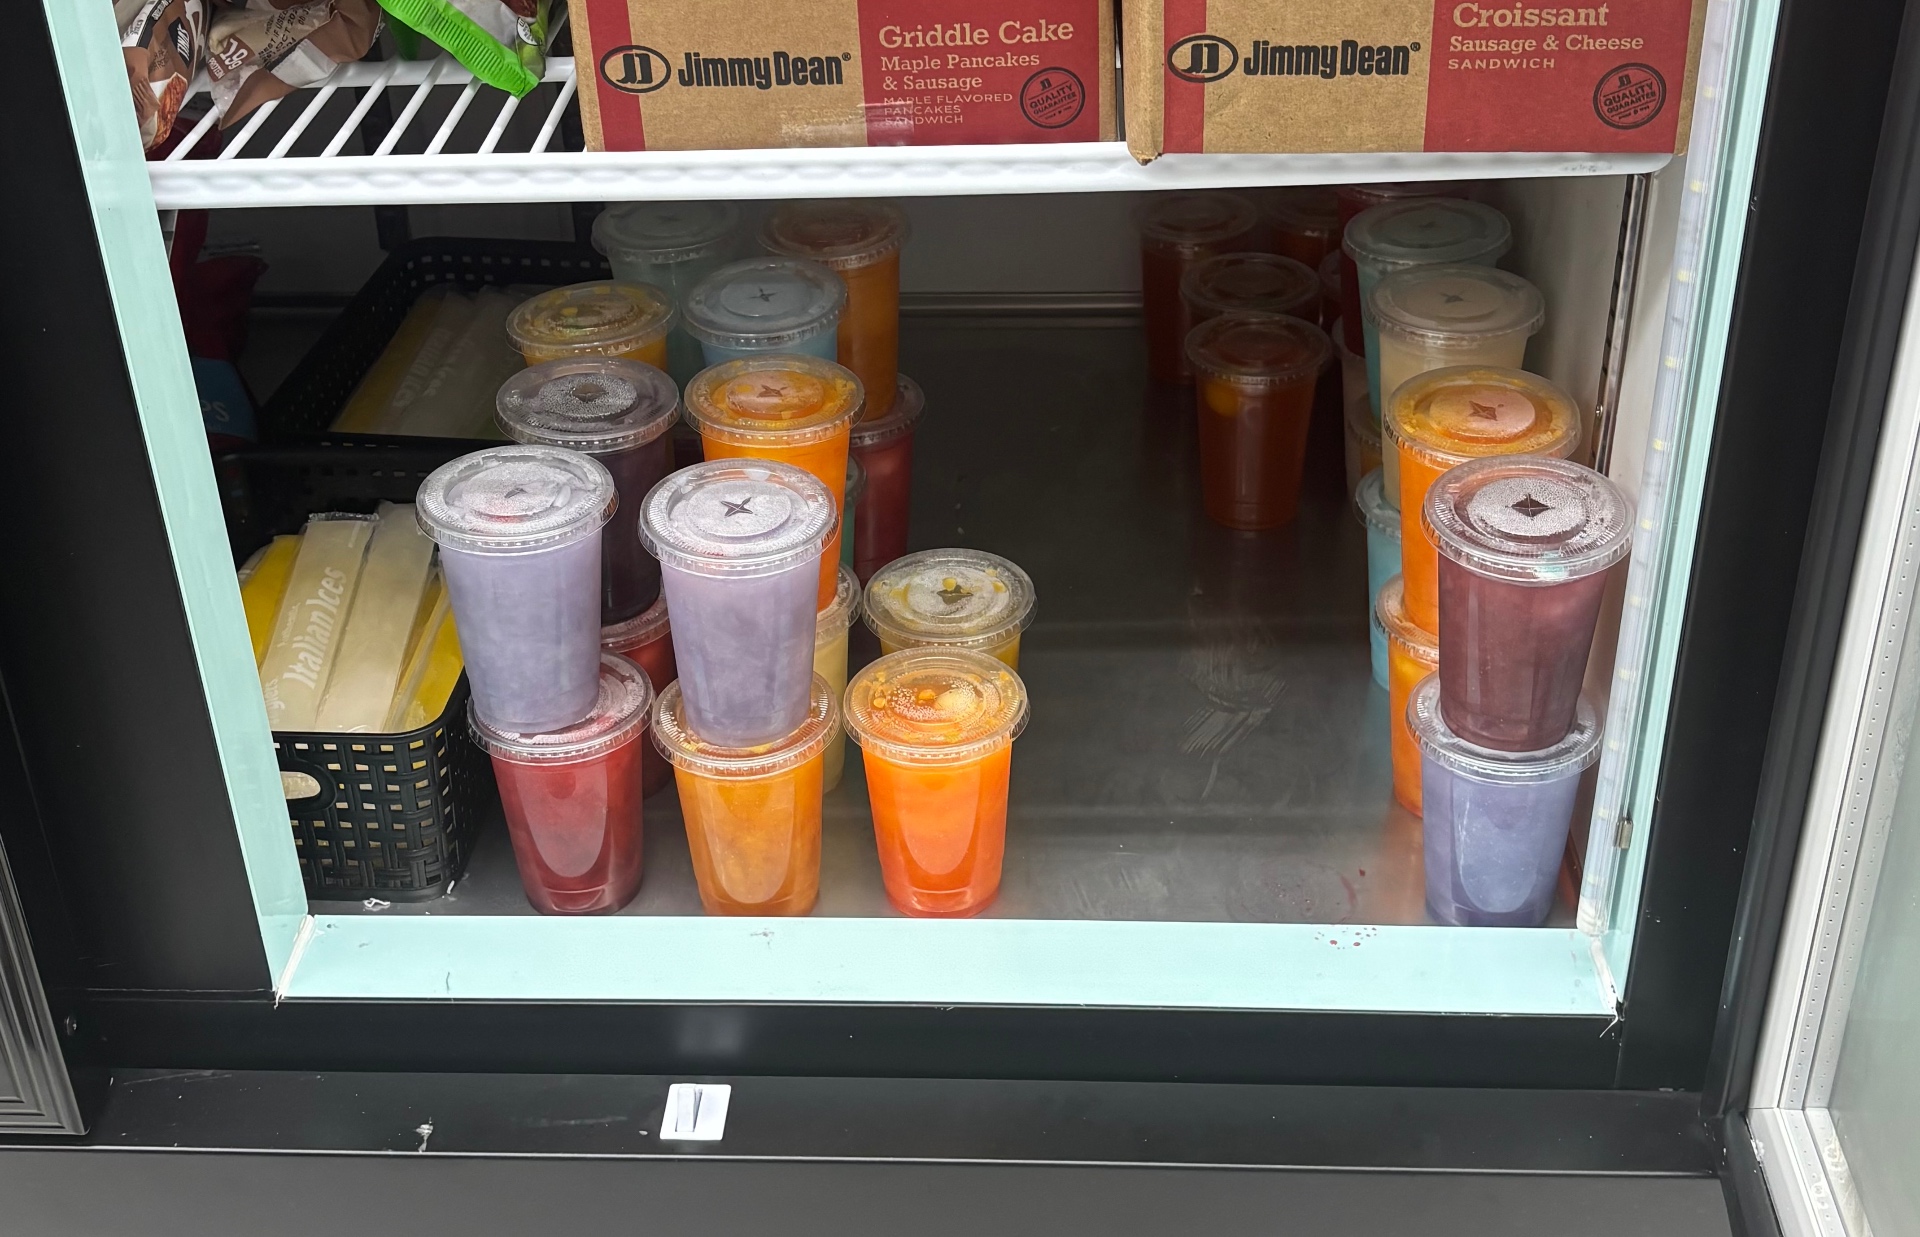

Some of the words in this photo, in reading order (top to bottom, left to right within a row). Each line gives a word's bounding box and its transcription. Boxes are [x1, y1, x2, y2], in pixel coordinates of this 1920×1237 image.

[1453, 2, 1610, 28] Croissant
[878, 22, 990, 49] Griddle
[998, 18, 1074, 44] Cake
[1450, 35, 1537, 55] Sausage
[1542, 34, 1560, 51] &
[1565, 34, 1644, 50] Cheese
[207, 57, 226, 80] PROTEIN
[881, 55, 941, 73] Maple
[947, 52, 1040, 69] Pancakes
[1448, 58, 1555, 70] SANDWICH
[882, 76, 898, 91] &
[903, 75, 983, 92] Sausage
[1604, 81, 1653, 107] QUALITY
[884, 96, 931, 105] MAPLE
[937, 93, 1013, 104] FLAVORED
[1030, 83, 1073, 109] QUALITY
[884, 105, 961, 115] PANCAKES
[885, 115, 964, 125] SANDWICH
[306, 566, 348, 615] Ices
[282, 607, 335, 690] Italian
